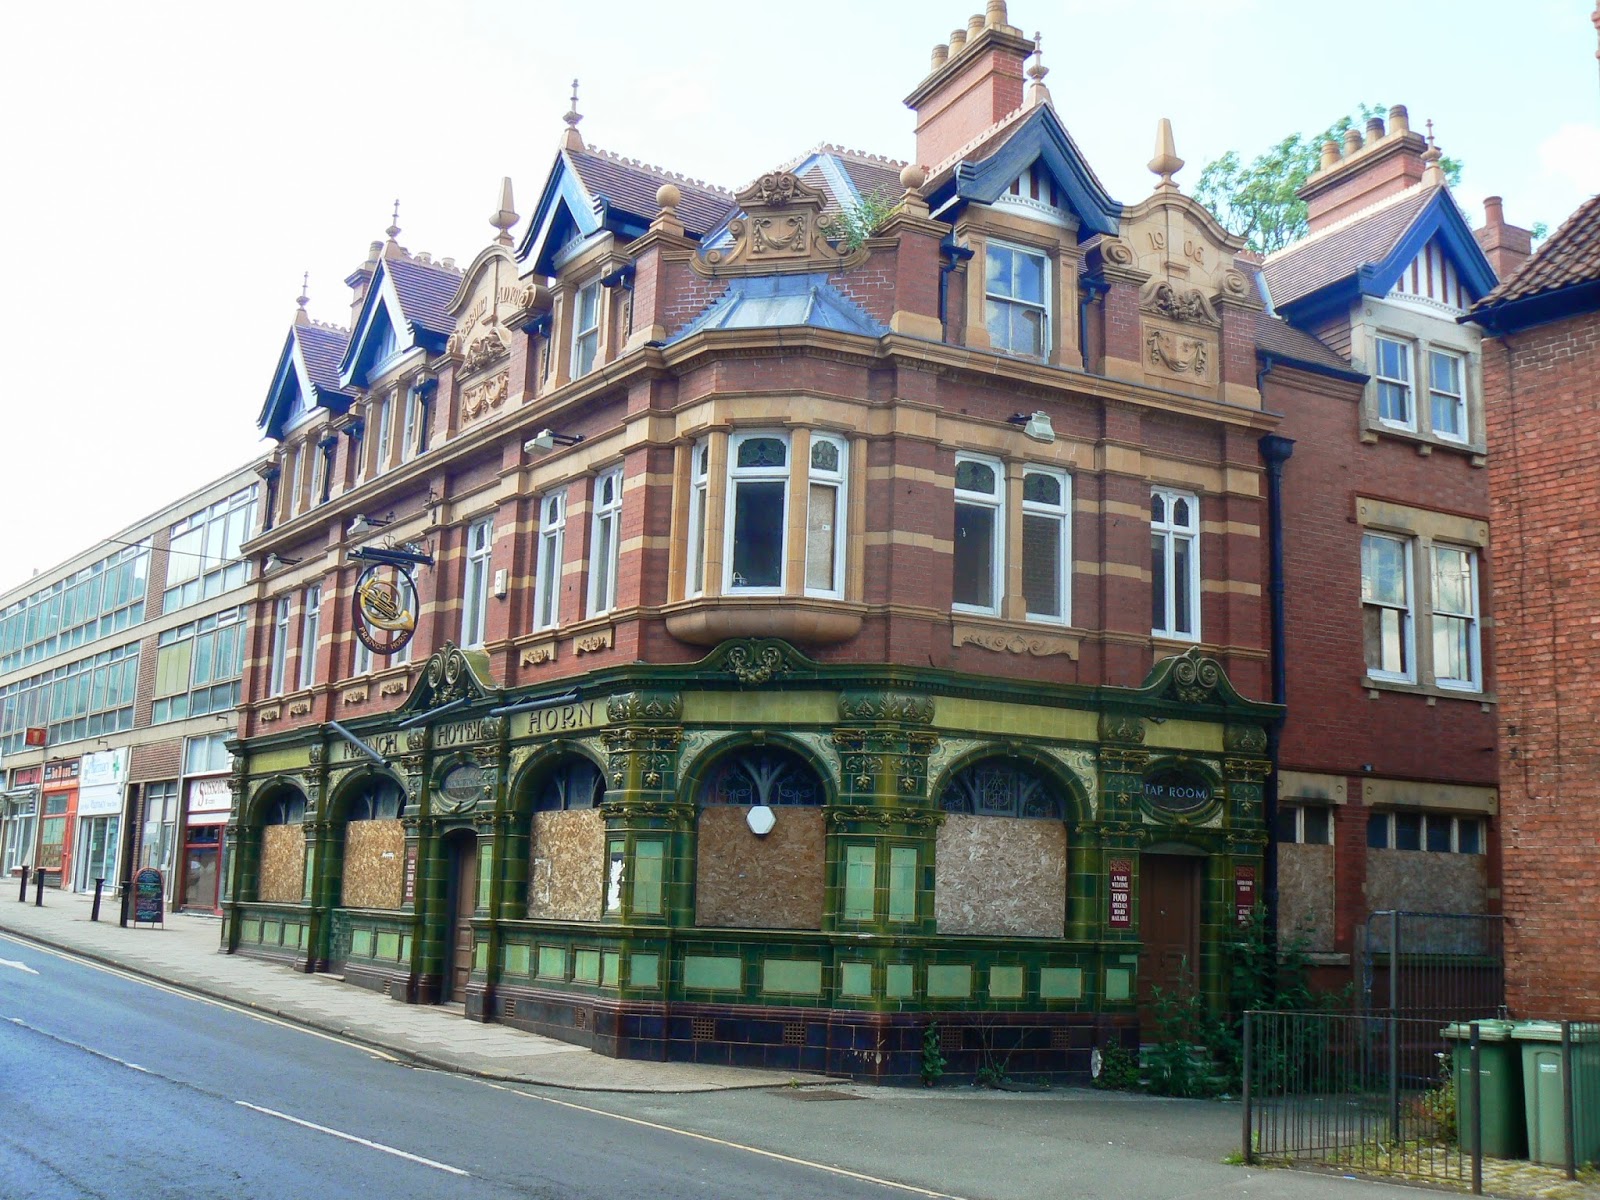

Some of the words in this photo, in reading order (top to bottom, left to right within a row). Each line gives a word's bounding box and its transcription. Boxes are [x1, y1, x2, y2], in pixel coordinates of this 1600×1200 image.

[359, 626, 387, 651] FRENCH
[390, 631, 409, 650] HORN
[437, 719, 484, 746] HOTEL
[528, 702, 595, 733] HORN
[1145, 783, 1164, 795] TAP
[1169, 786, 1205, 799] ROOM
[1112, 893, 1128, 902] FOOD
